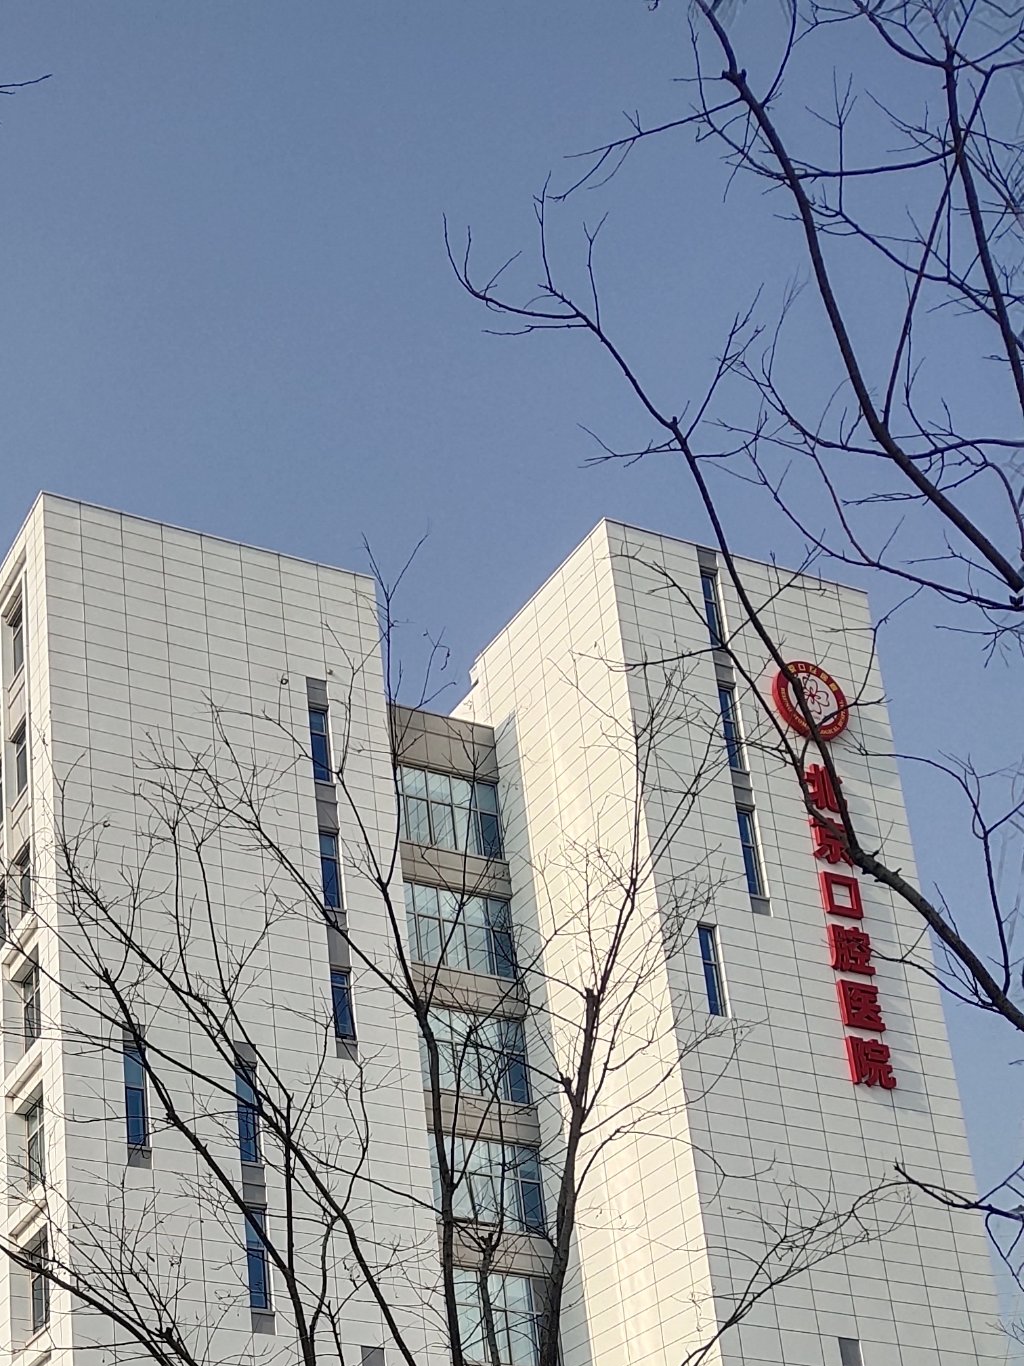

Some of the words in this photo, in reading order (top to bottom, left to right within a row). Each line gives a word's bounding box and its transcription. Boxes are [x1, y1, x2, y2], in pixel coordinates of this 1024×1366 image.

[804, 763, 897, 1089] 北京口腔医院
